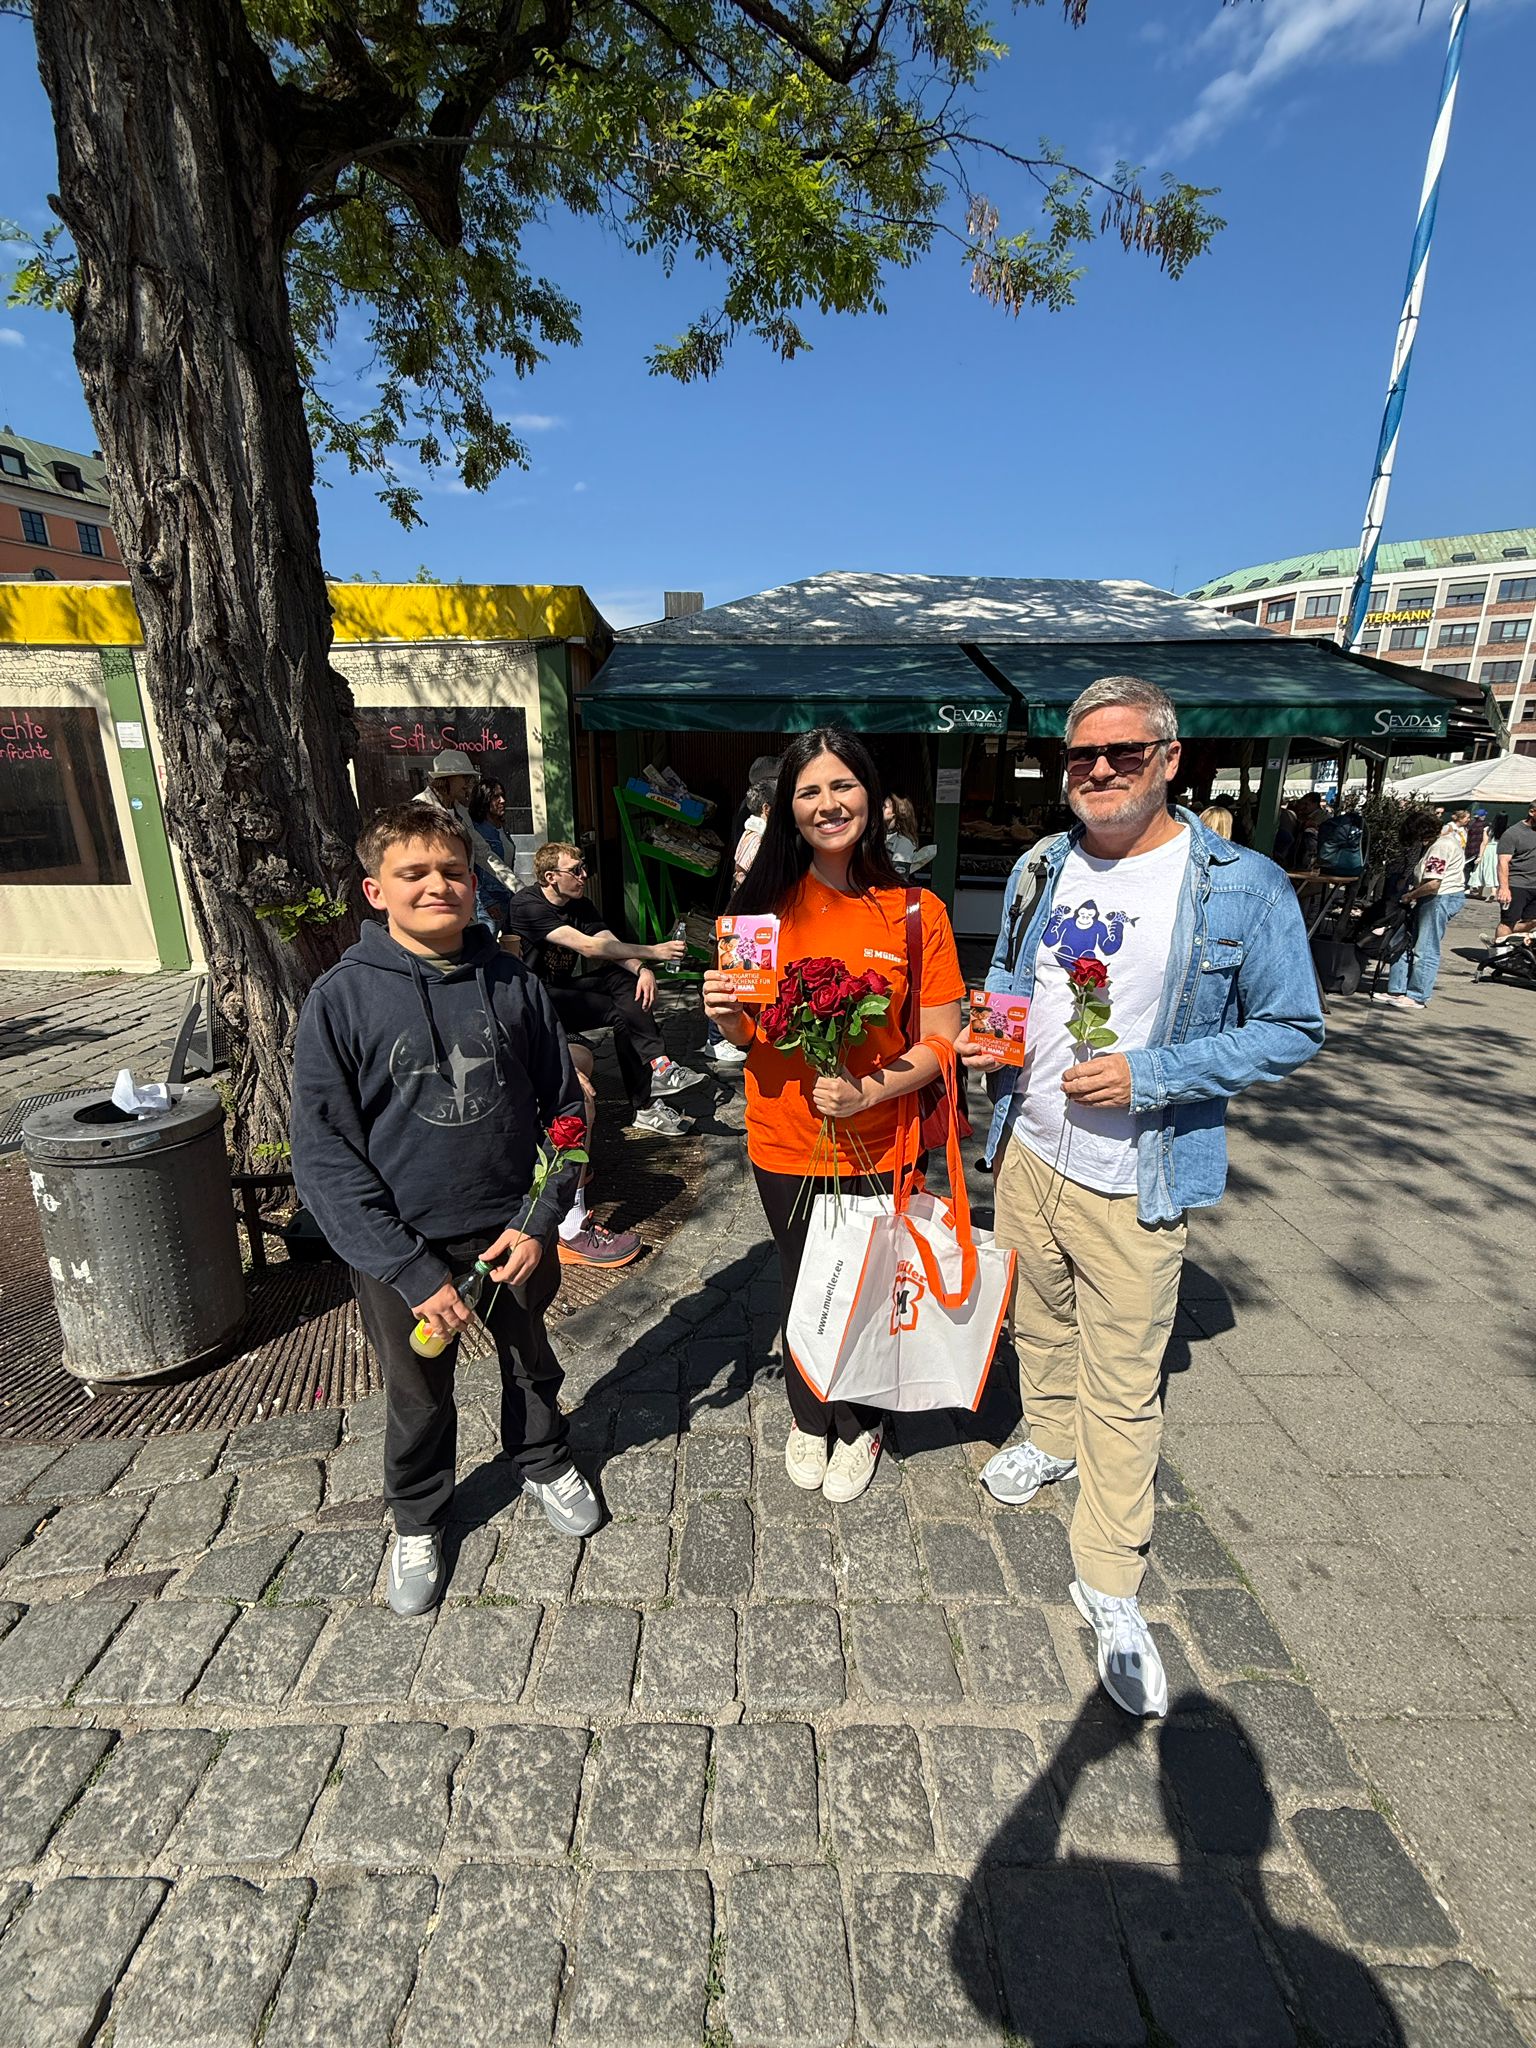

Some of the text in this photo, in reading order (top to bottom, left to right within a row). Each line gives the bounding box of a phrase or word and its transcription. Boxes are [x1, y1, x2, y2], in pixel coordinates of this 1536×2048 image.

[1371, 709, 1442, 735] SEVDAS
[389, 723, 426, 752] Soft
[441, 726, 508, 752] Smoothie
[874, 950, 902, 963] Müller
[817, 1260, 844, 1335] www.mueller.eu
